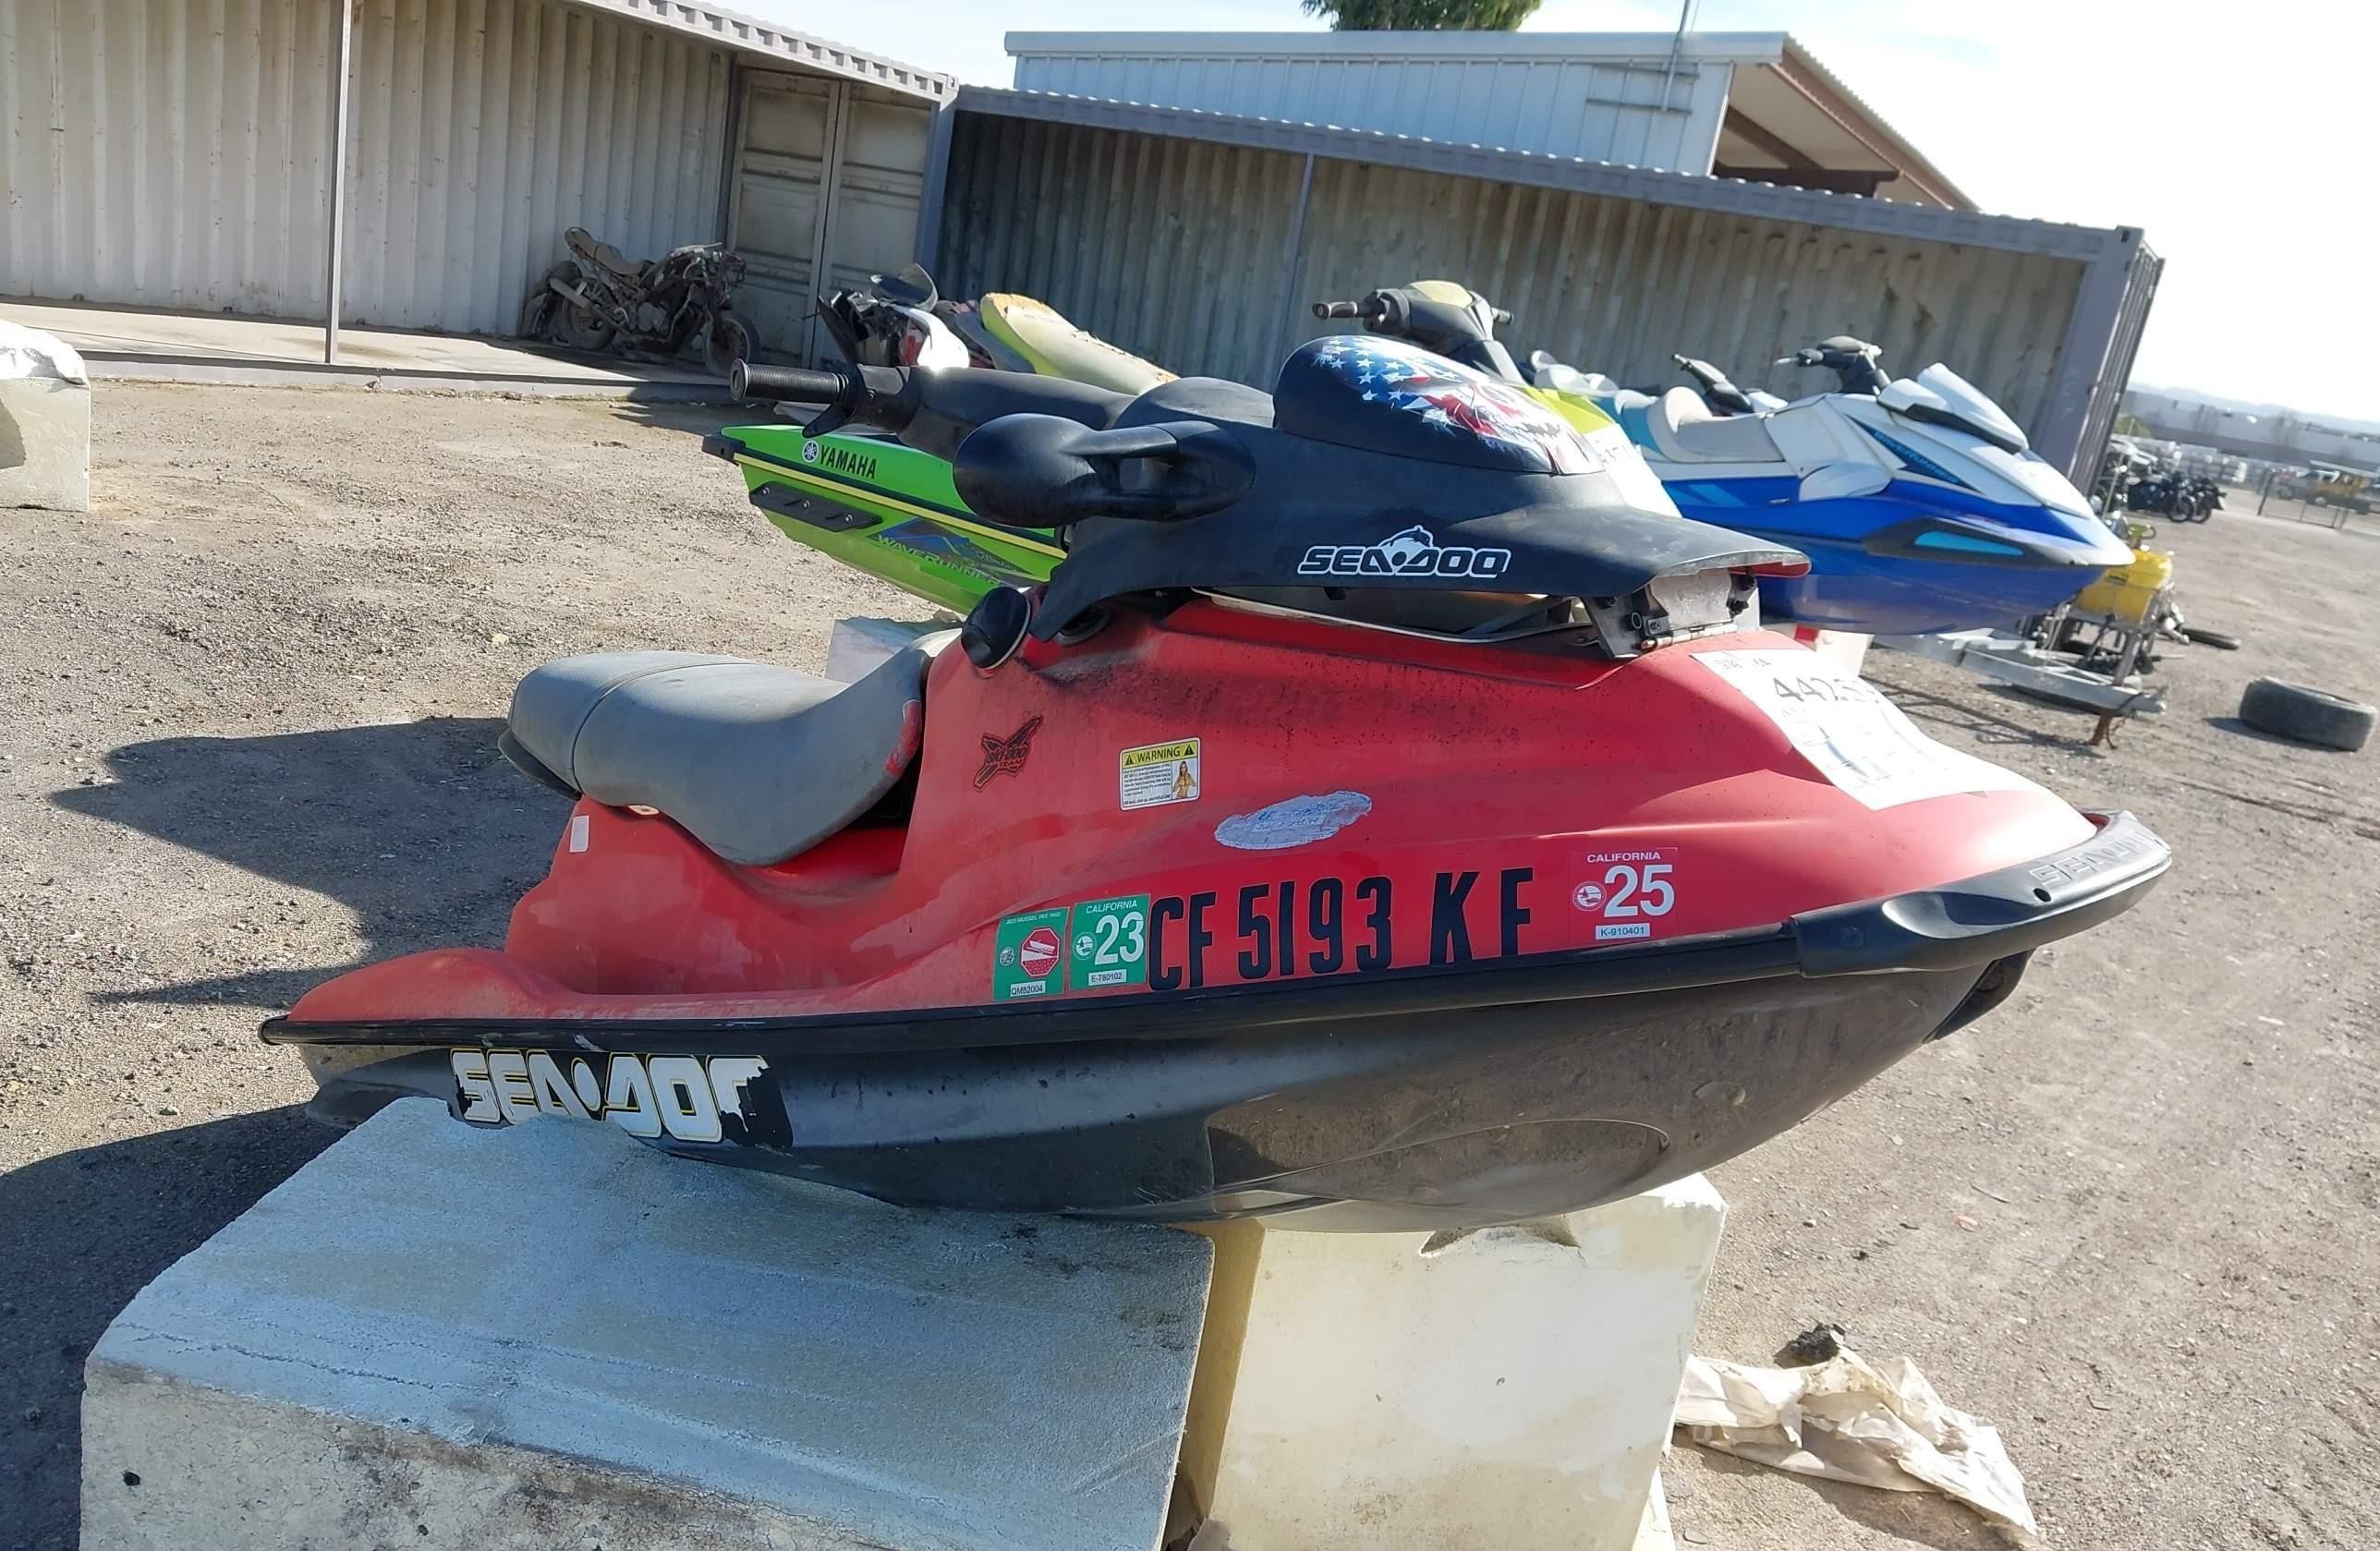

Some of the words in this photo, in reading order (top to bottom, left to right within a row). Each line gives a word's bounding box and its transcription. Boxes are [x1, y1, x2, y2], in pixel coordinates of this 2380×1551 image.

[820, 444, 877, 479] YAMAHA
[1136, 746, 1181, 763] WARNING
[1587, 852, 1661, 863] CALIFORNIA
[1604, 864, 1675, 918] 25
[1086, 900, 1137, 914] CALIFORNIA
[1094, 911, 1145, 965] 23
[1148, 891, 1216, 991] CF
[1238, 877, 1392, 980] 5193
[1600, 926, 1645, 937] K-910401
